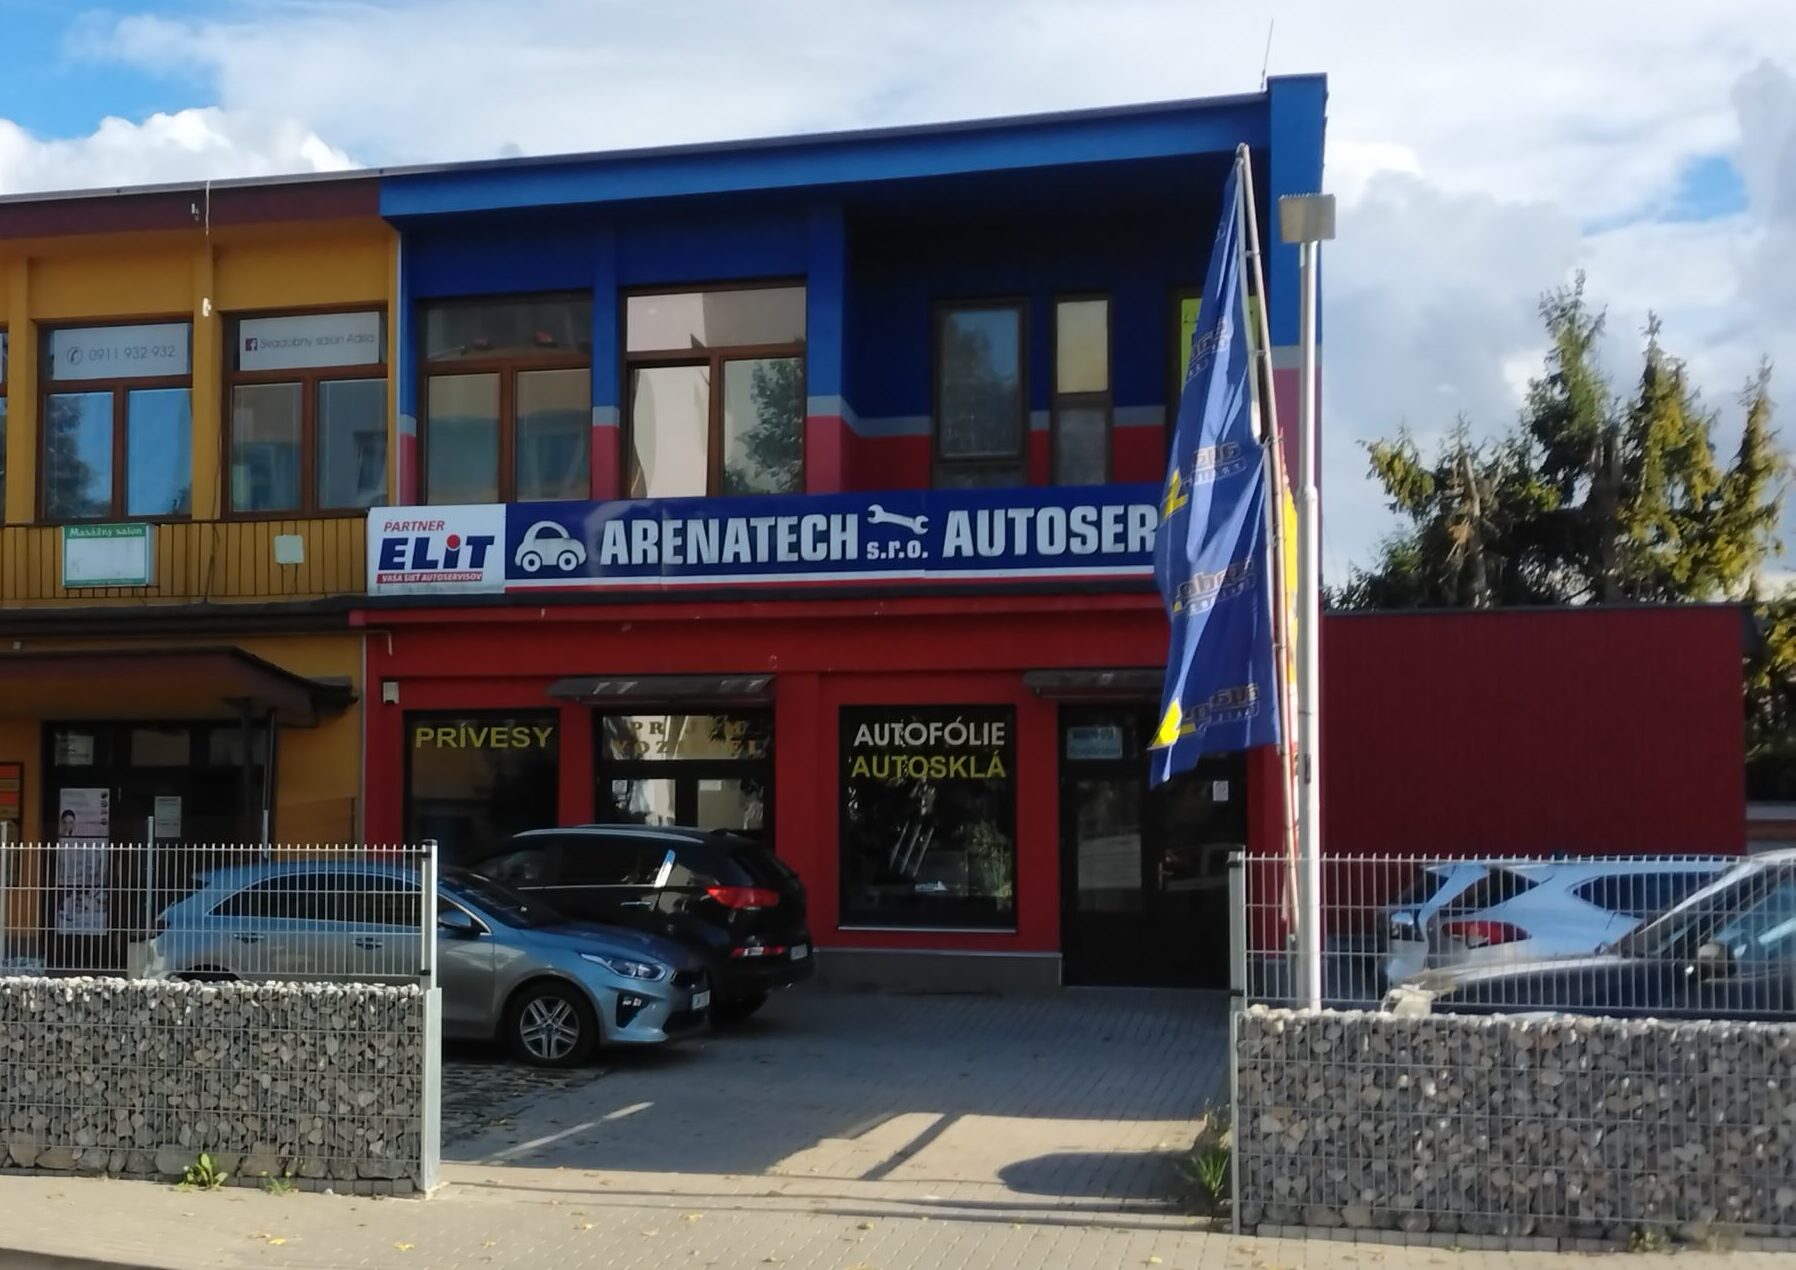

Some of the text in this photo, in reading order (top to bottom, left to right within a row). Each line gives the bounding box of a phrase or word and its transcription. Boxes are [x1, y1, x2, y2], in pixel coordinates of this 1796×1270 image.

[88, 344, 176, 361] 0911 932 932
[384, 520, 445, 532] PARTNER
[600, 514, 858, 565] ARENATECH
[866, 540, 928, 560] s.r.o.
[416, 722, 554, 748] PRÍVESY
[853, 716, 1005, 746] AUTOFÓLIE
[851, 751, 1006, 778] AUTOSKLÁ
